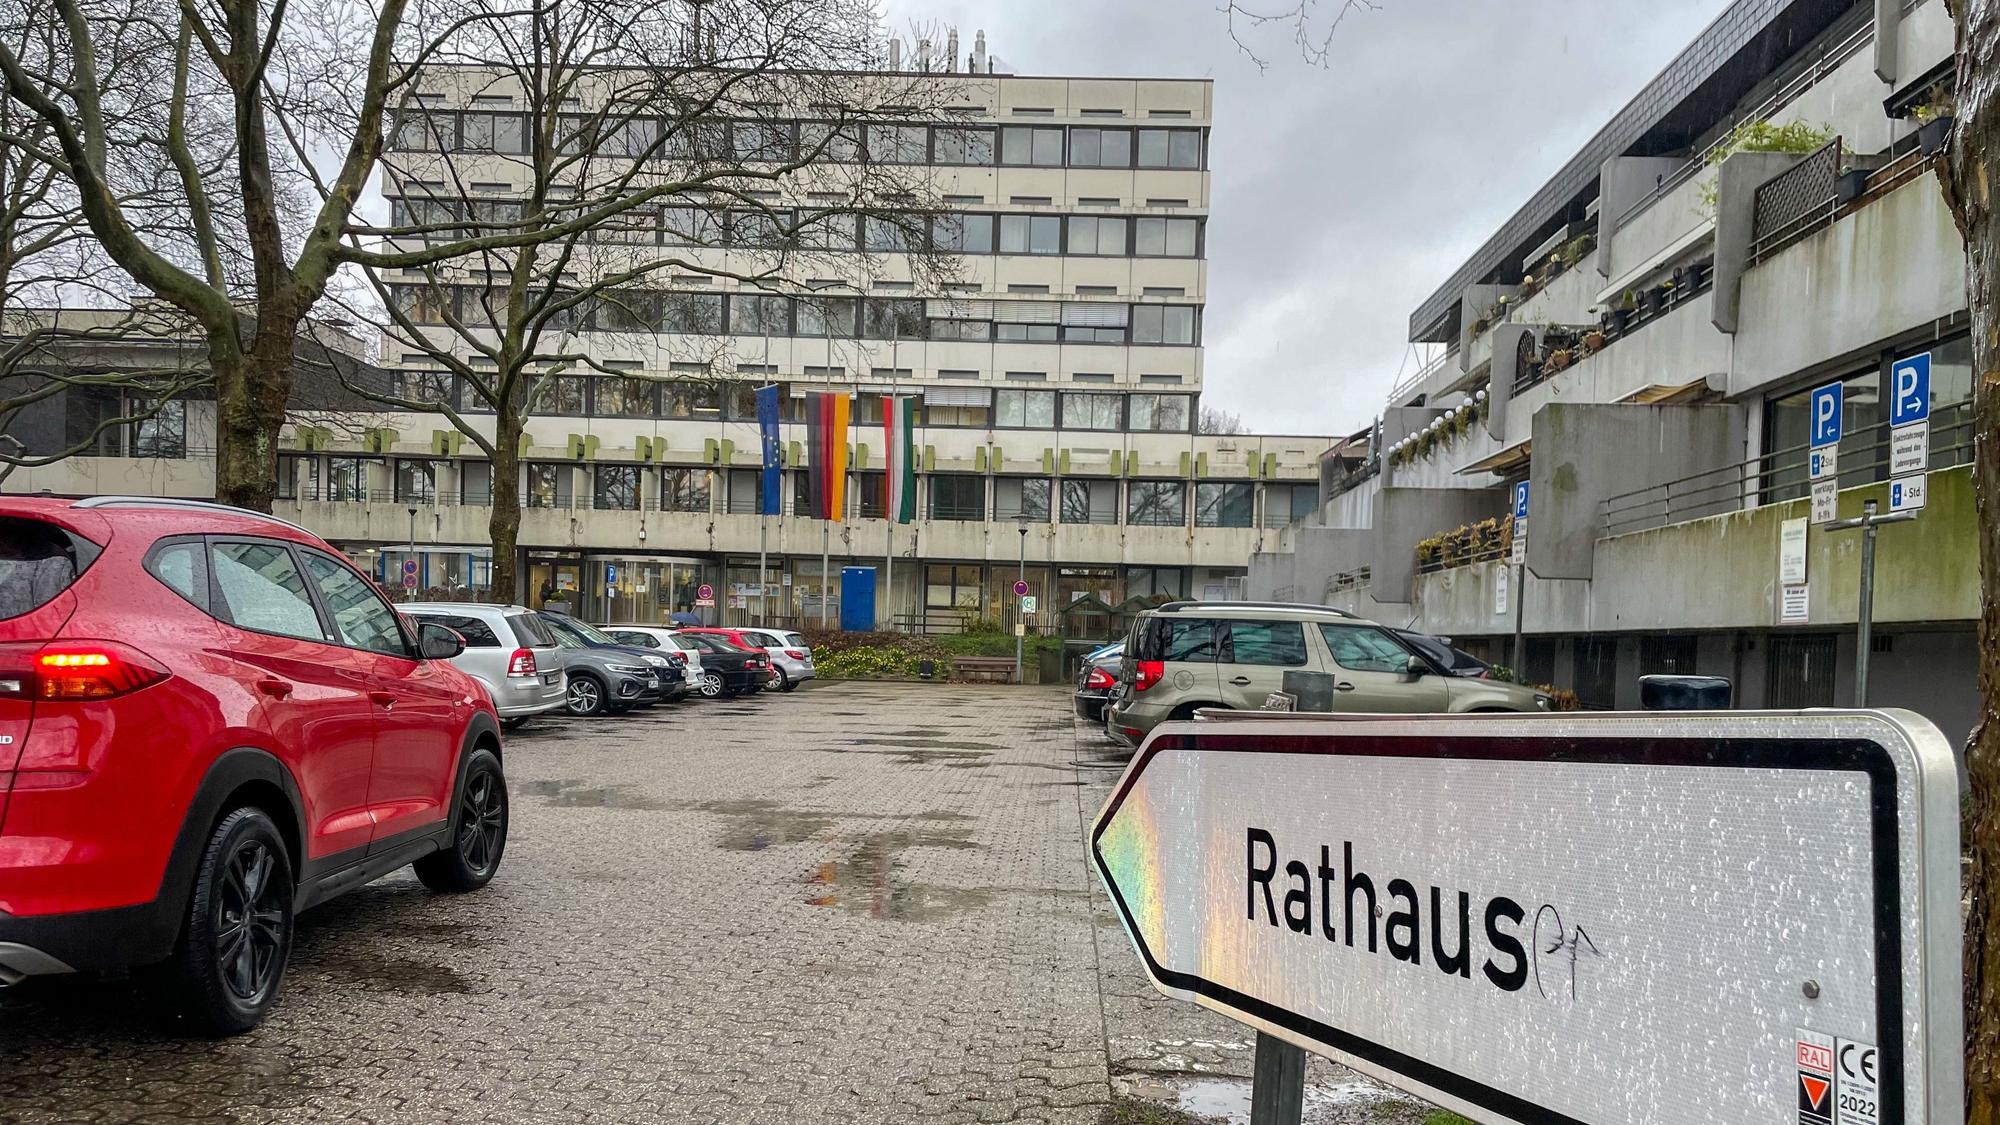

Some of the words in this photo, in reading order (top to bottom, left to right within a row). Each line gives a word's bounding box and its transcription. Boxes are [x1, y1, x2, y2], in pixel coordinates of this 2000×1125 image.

[1897, 366, 1918, 417] P
[1817, 393, 1835, 440] P
[1820, 455, 1825, 468] 2
[1517, 487, 1526, 514] P
[1246, 826, 1528, 992] Rathaus
[1800, 1048, 1828, 1068] RAL
[1839, 1043, 1876, 1084] CE
[1840, 1094, 1876, 1118] 2022
